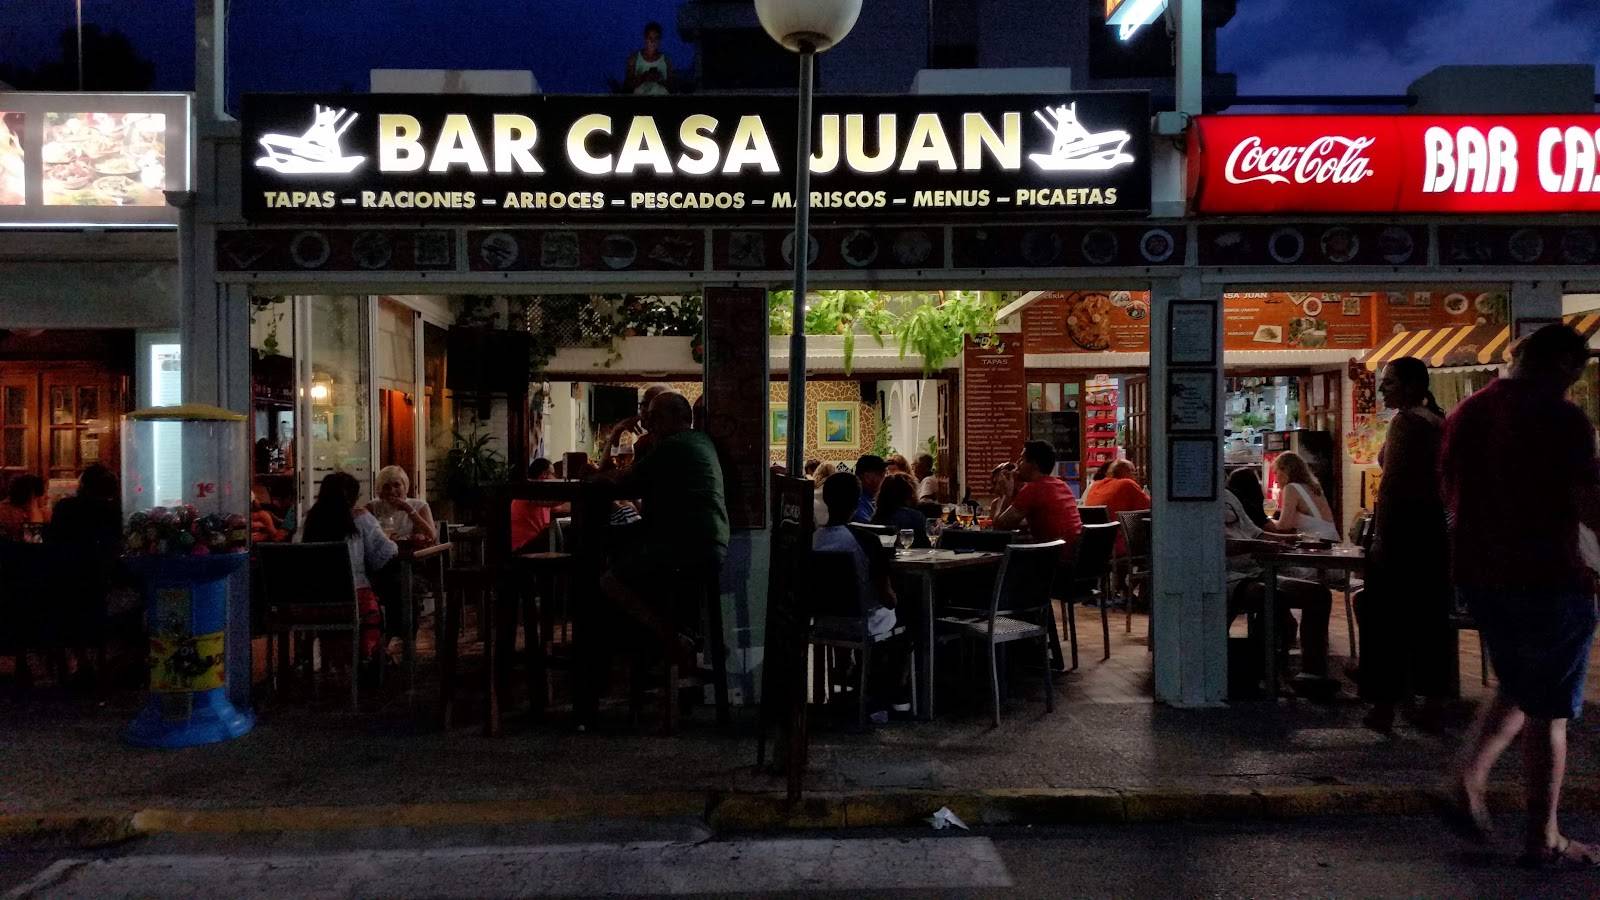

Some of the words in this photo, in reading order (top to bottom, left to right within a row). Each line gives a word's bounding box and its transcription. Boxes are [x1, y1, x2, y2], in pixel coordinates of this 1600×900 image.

[378, 113, 545, 174] BAR
[566, 113, 781, 175] CASA
[806, 111, 1022, 174] JUAN
[1225, 135, 1375, 185] Coca-Cola
[1422, 126, 1519, 193] BAR
[264, 190, 336, 209] TAPAS
[361, 190, 476, 209] RACIONES
[502, 191, 605, 209] ARROCES
[630, 191, 746, 209] PESCADOS
[771, 190, 887, 209] MRISCOS
[912, 189, 991, 208] MENUS
[1016, 187, 1118, 206] PICAETAS
